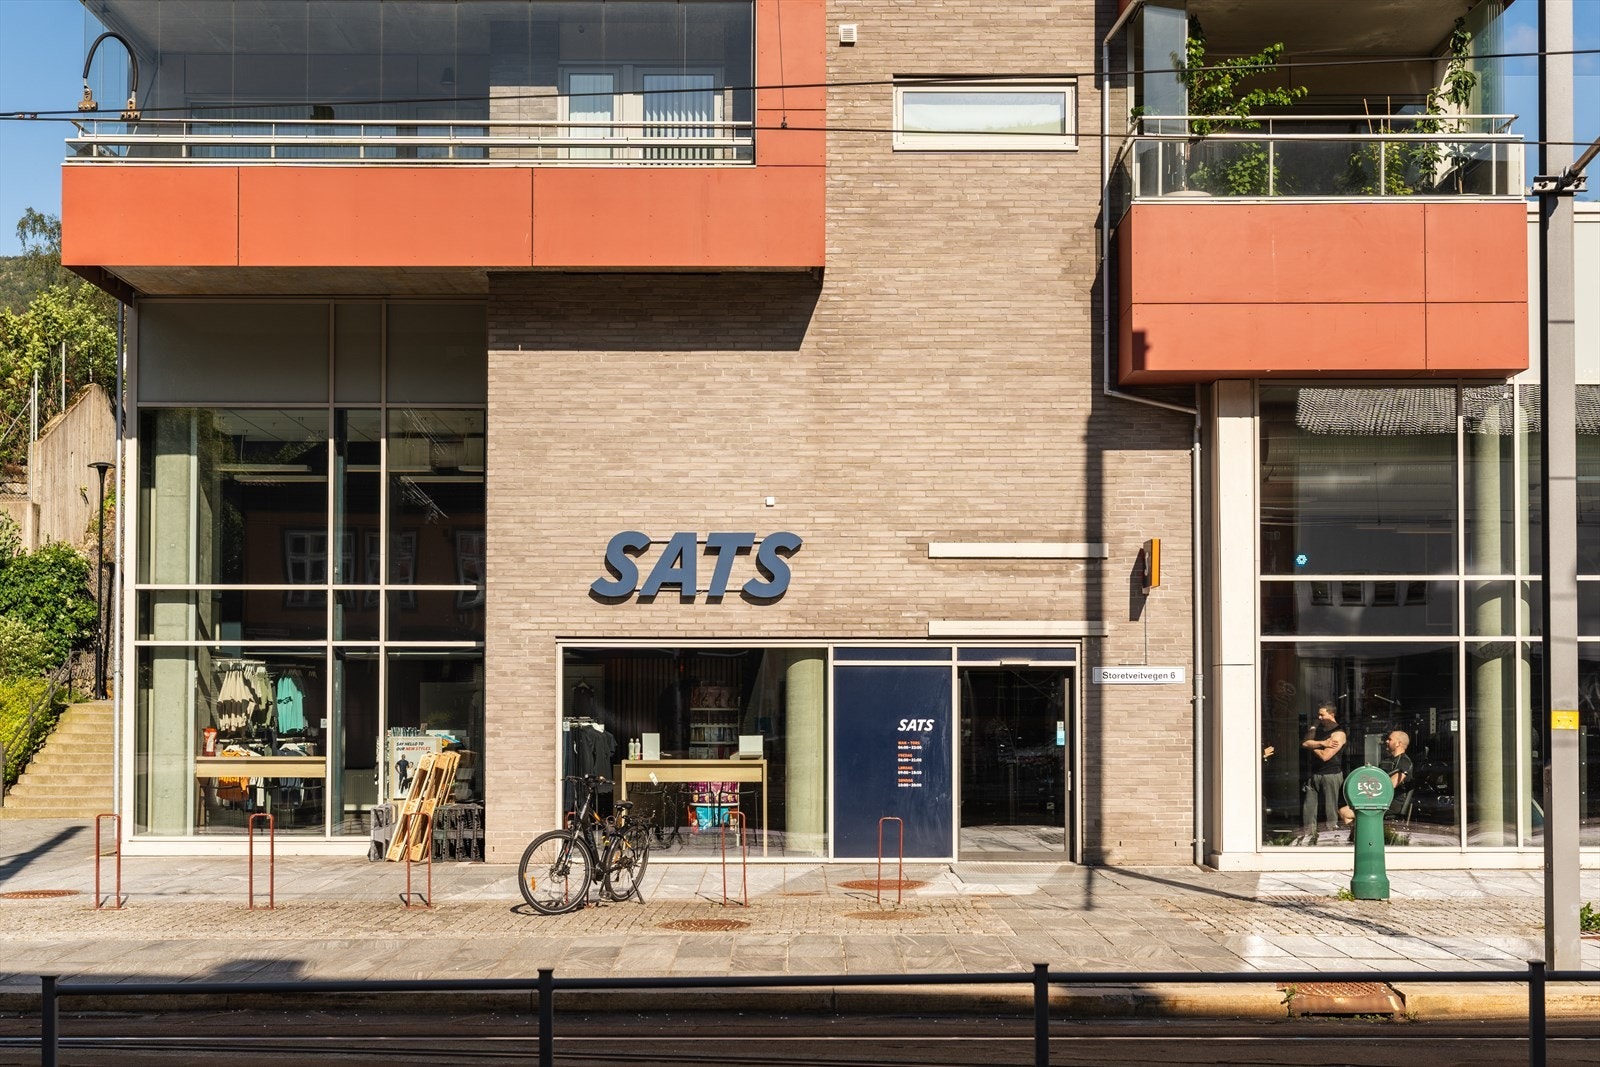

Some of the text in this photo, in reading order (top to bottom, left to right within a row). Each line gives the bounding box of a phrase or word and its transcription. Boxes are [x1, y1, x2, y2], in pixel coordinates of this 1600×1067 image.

[589, 531, 803, 605] SATS
[1102, 672, 1176, 680] Storetveitvegen 6
[897, 719, 935, 731] SATS
